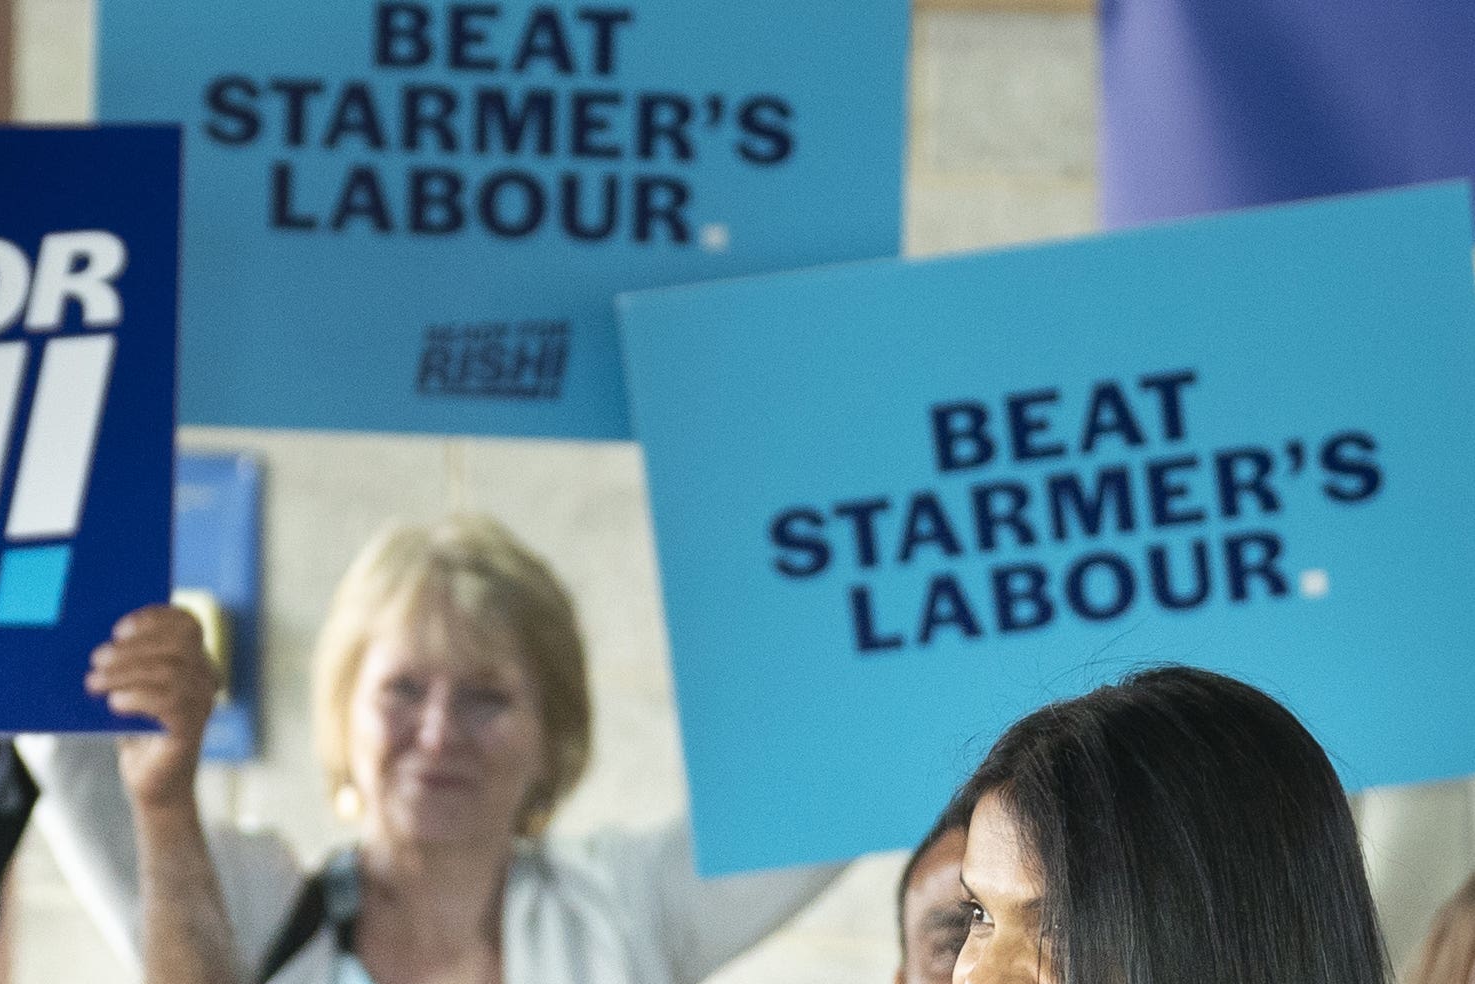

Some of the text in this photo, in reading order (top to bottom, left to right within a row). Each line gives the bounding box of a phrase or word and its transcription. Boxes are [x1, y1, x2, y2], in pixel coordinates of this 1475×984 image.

[374, 0, 631, 76] BEAT
[204, 75, 797, 167] STARMER’S
[268, 160, 728, 250] LABOUR.
[930, 368, 1199, 474] BEAT
[768, 430, 1383, 580] STARMER’S
[846, 530, 1328, 654] LABOUR.
